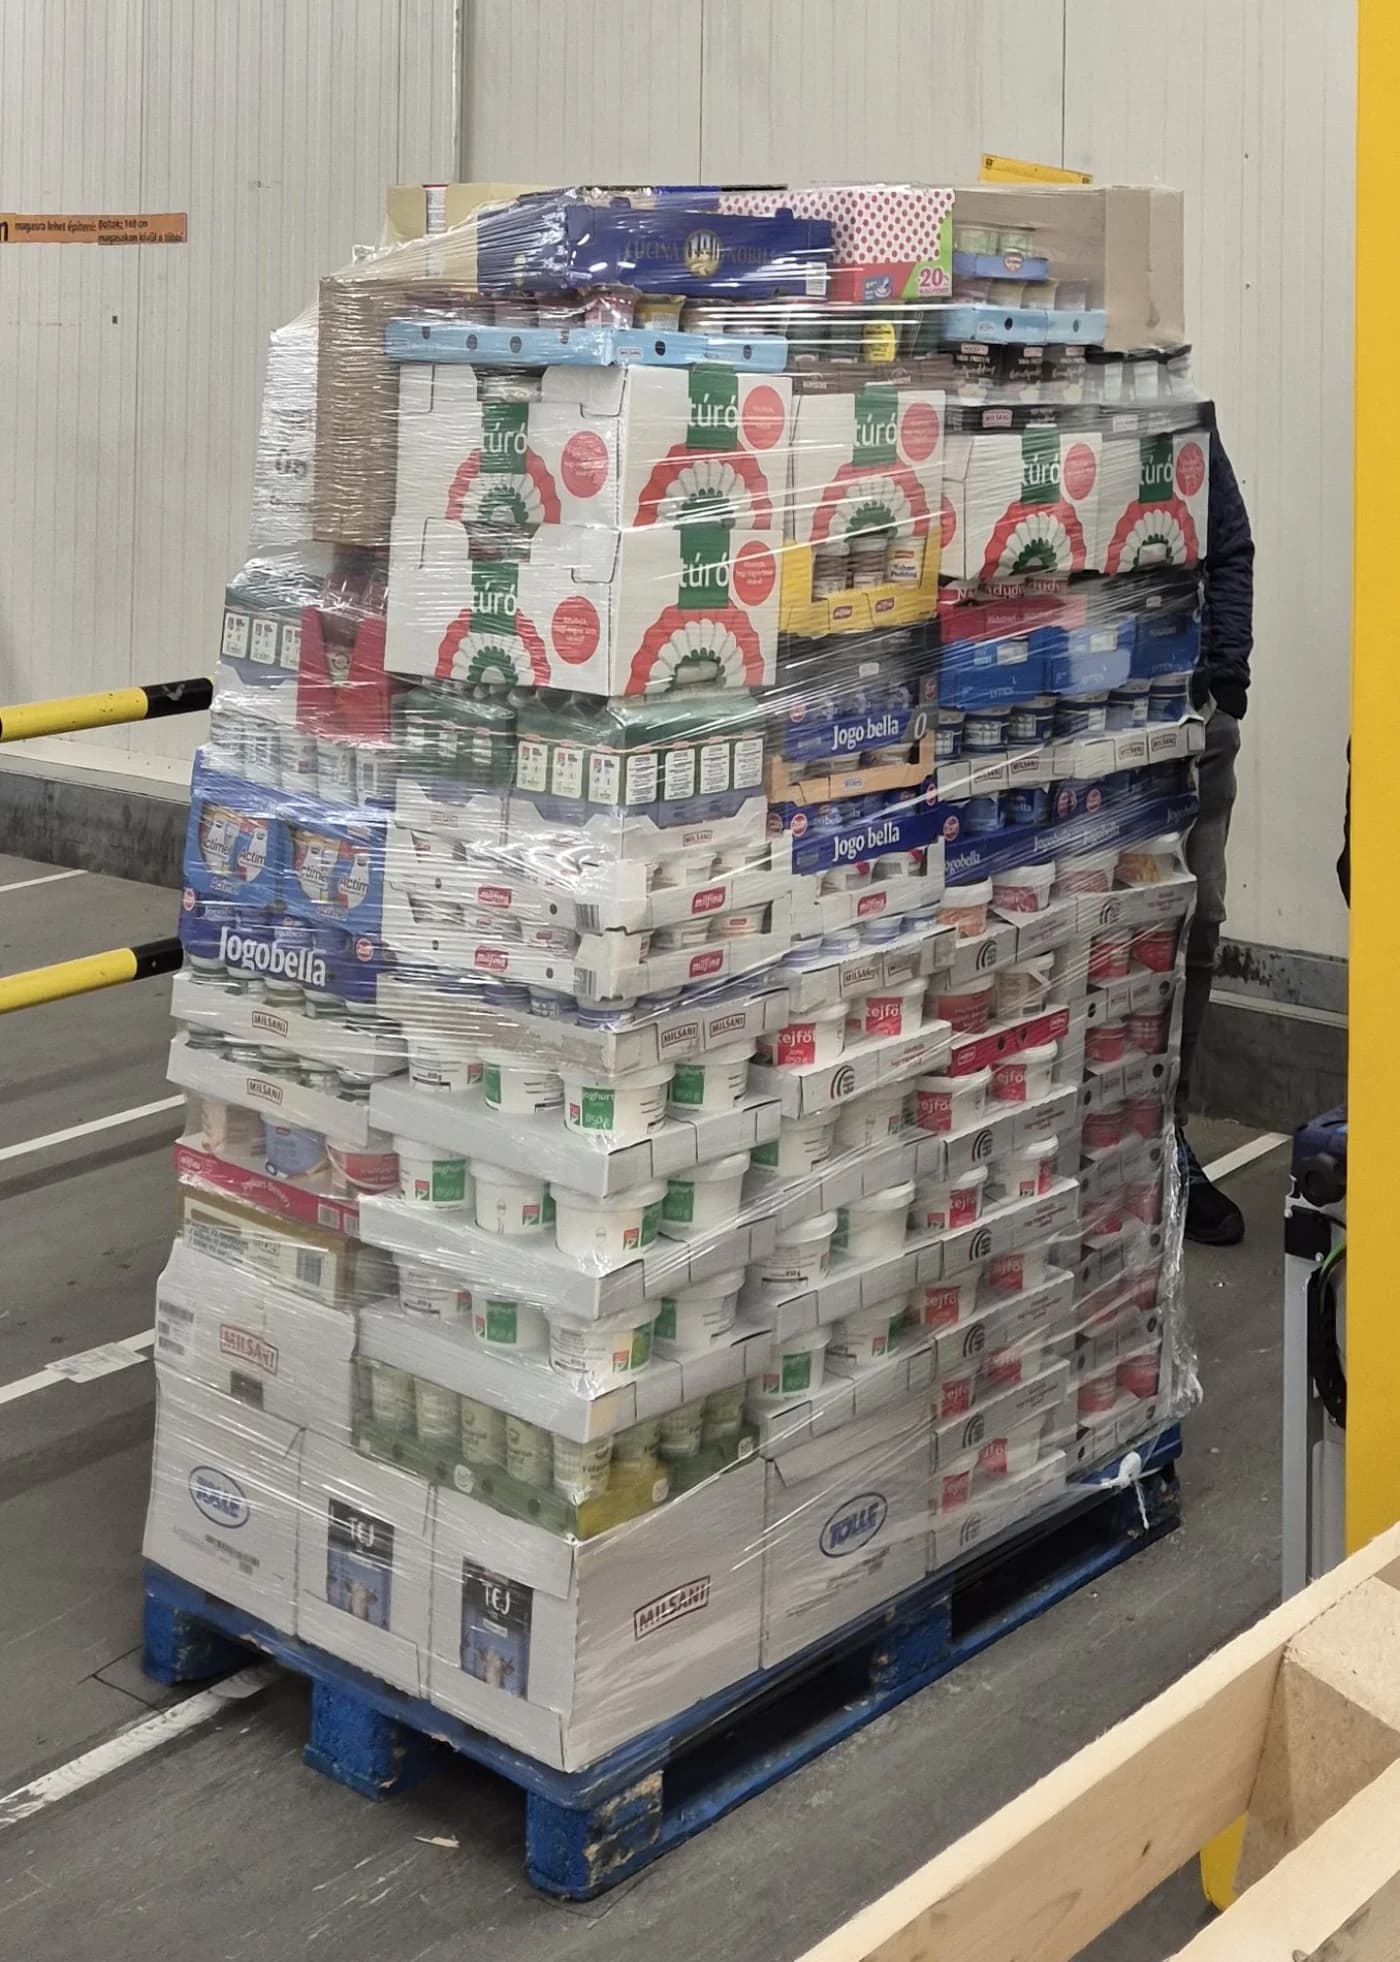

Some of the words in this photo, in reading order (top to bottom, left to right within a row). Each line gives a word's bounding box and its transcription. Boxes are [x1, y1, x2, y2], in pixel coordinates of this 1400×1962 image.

[919, 267, 944, 287] 20
[218, 926, 327, 988] Jogobella
[254, 1014, 287, 1033] MILSANI
[712, 1016, 744, 1033] MILSANI
[664, 1028, 697, 1043] MILSANI
[249, 1081, 282, 1100] MILSANI
[349, 1516, 375, 1547] TEJ
[481, 1581, 511, 1615] TEJ
[638, 1583, 710, 1632] MILSANI
